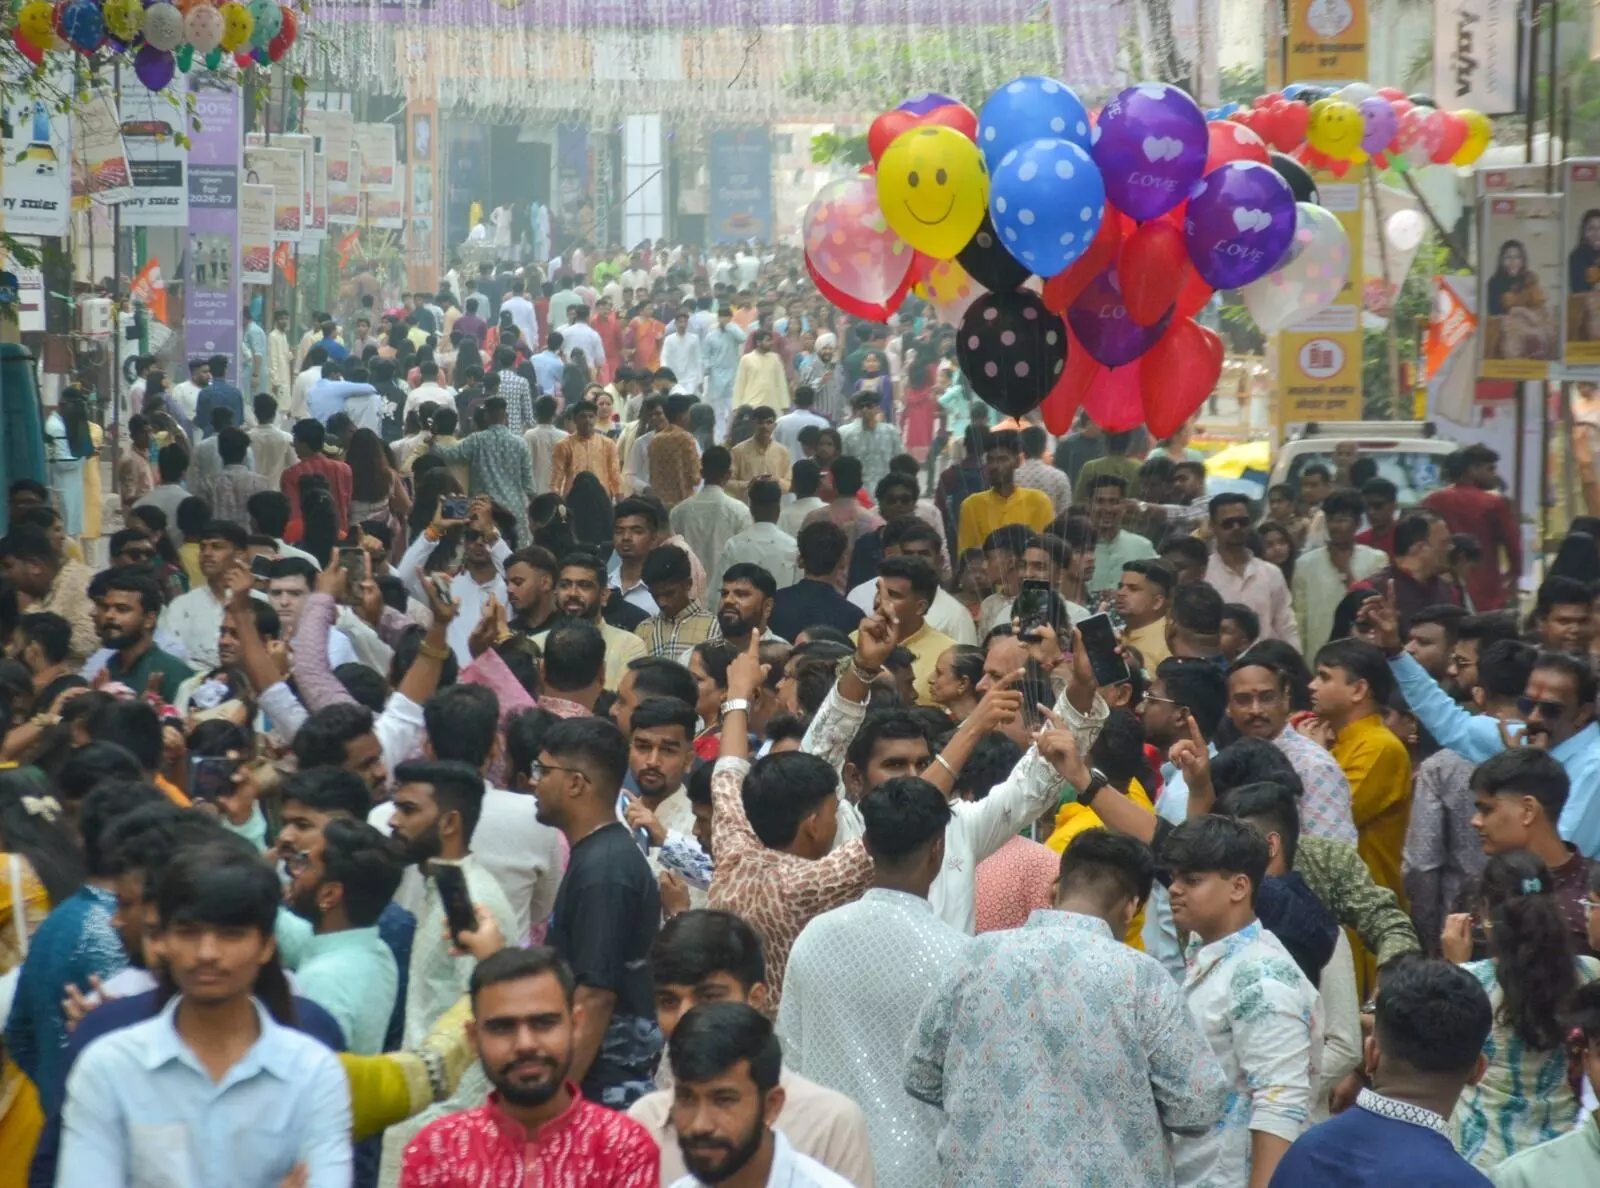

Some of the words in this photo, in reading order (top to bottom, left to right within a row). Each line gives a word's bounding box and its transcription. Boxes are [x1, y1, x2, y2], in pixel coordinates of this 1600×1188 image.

[202, 185, 218, 193] for
[1127, 171, 1179, 192] LOVE
[20, 198, 59, 211] sales
[1213, 239, 1265, 264] LOVE
[193, 300, 228, 308] LEGACY
[1098, 303, 1127, 320] LO
